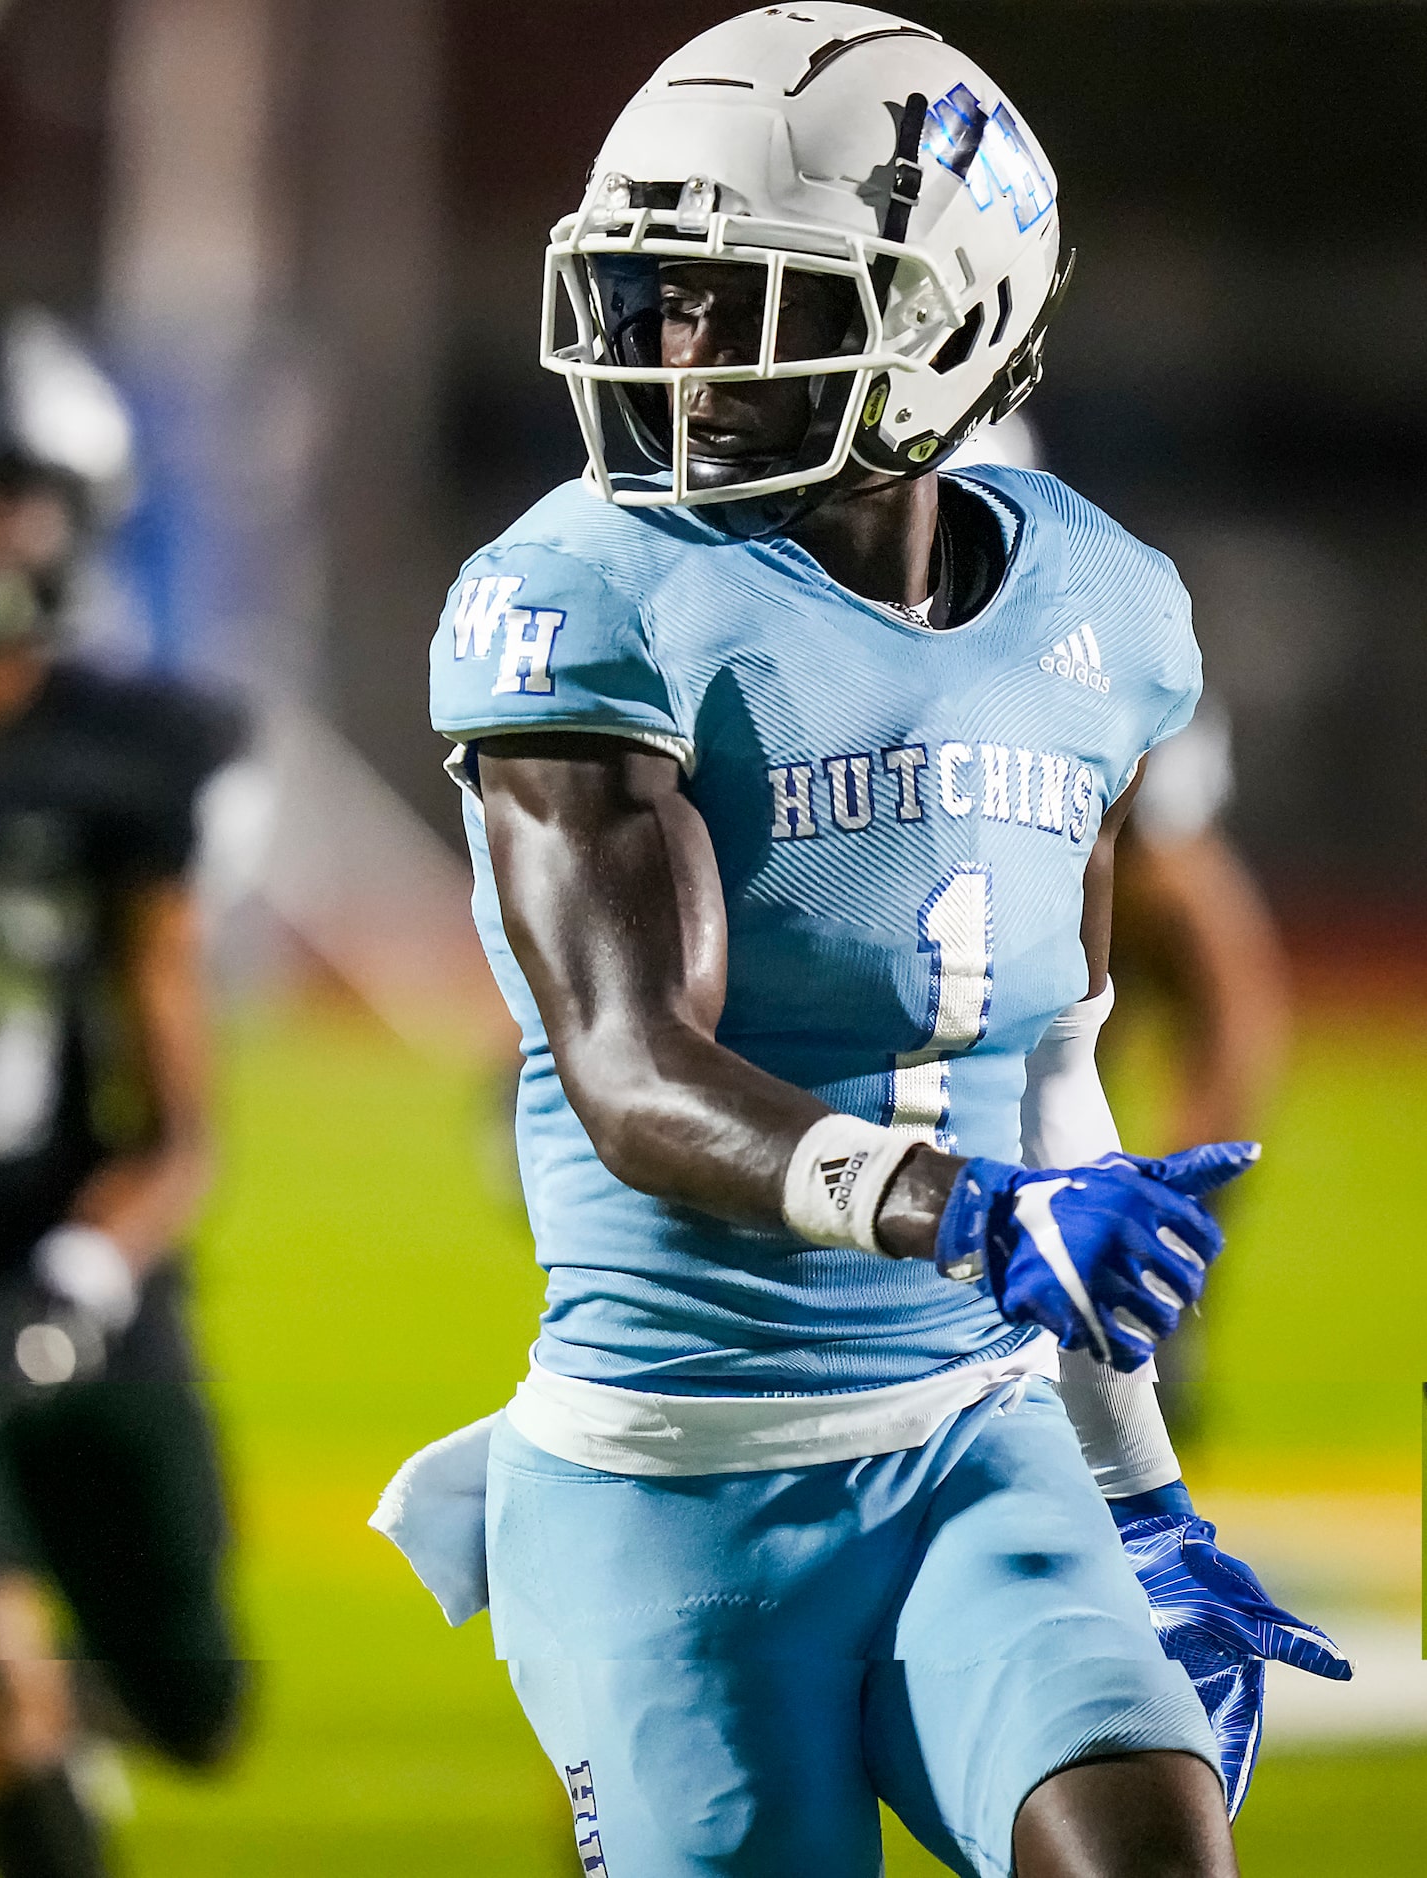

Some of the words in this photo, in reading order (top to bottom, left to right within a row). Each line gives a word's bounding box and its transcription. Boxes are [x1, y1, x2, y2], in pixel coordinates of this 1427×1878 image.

[453, 574, 569, 698] WH
[1037, 655, 1111, 694] adidas
[767, 742, 1094, 845] HUTCHINS
[880, 860, 994, 1156] 1
[834, 1150, 869, 1211] adidas
